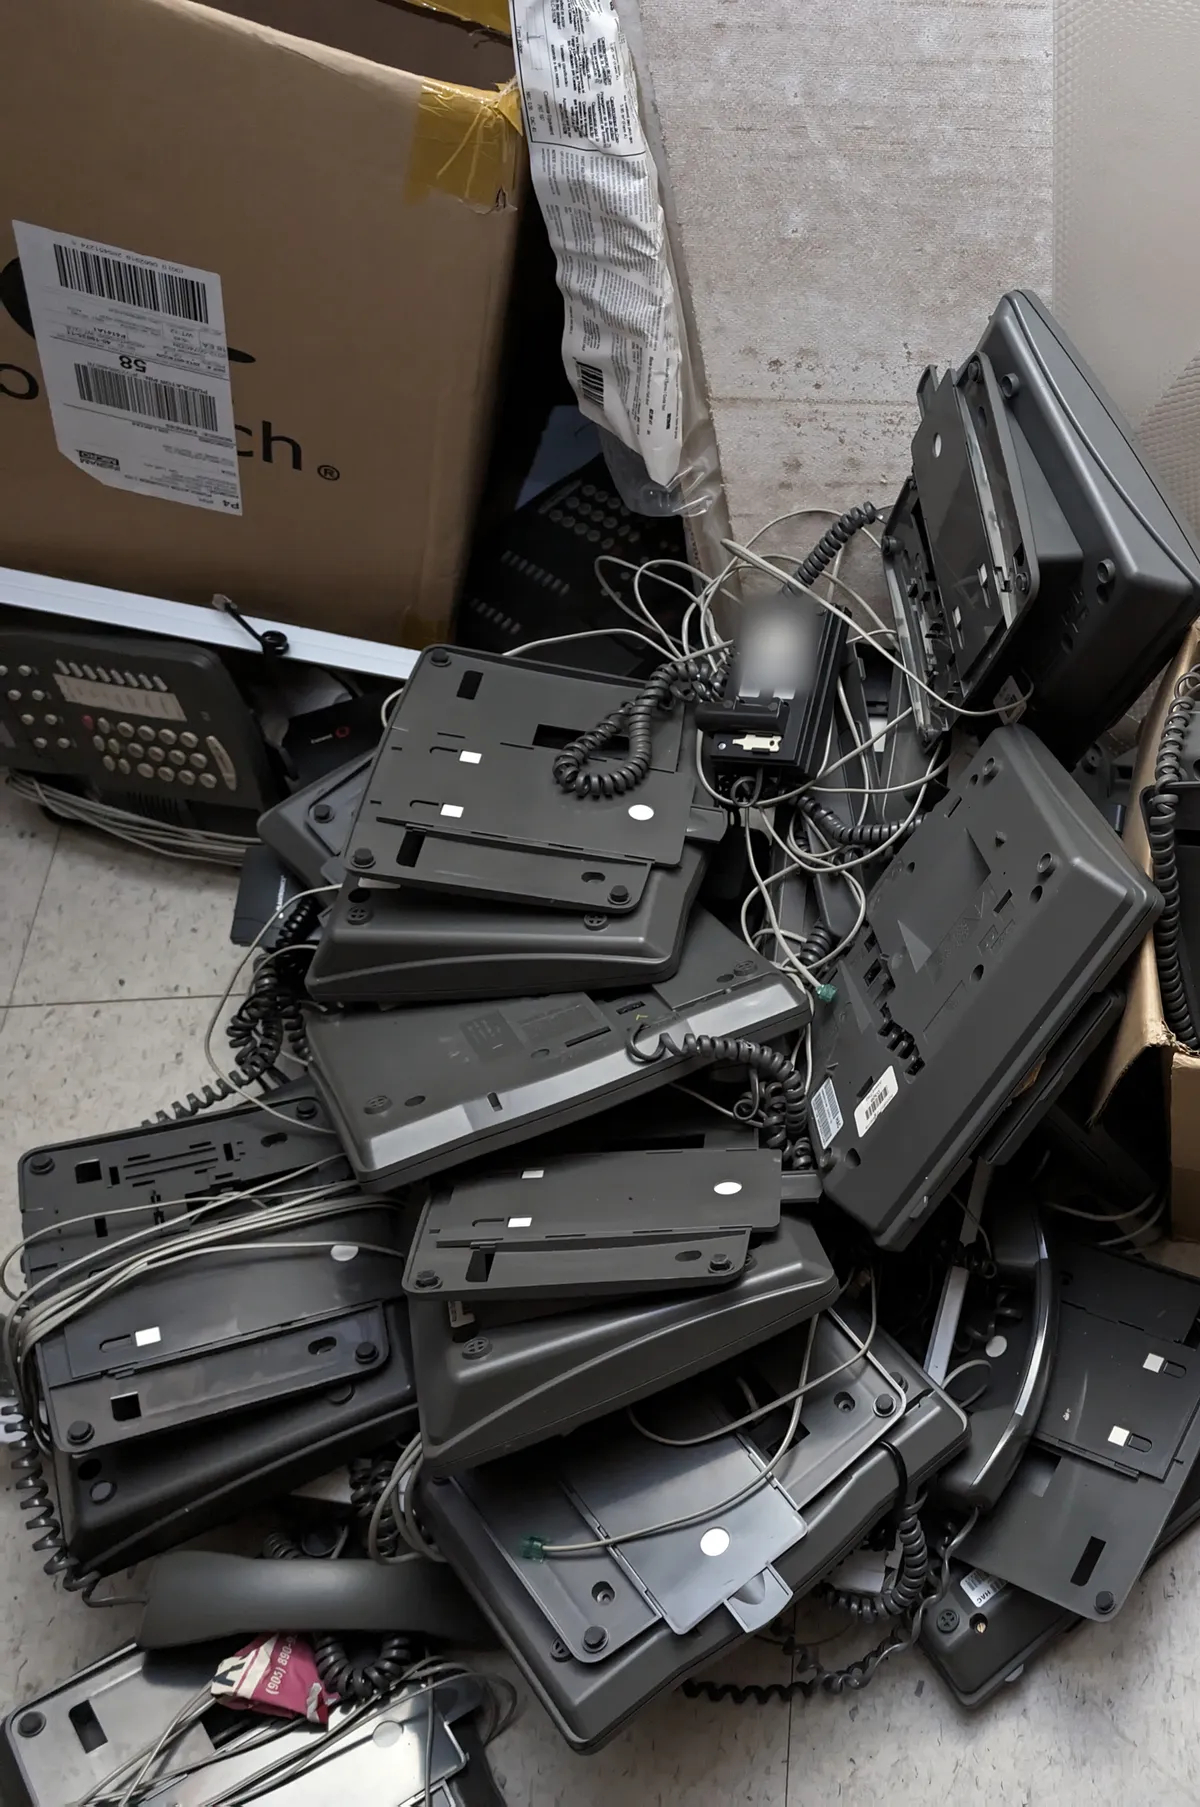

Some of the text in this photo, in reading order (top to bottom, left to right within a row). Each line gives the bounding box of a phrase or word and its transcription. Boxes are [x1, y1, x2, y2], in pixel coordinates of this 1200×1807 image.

[119, 354, 148, 374] 58
[977, 1589, 991, 1604] HAC
[265, 1667, 287, 1695] (905)
